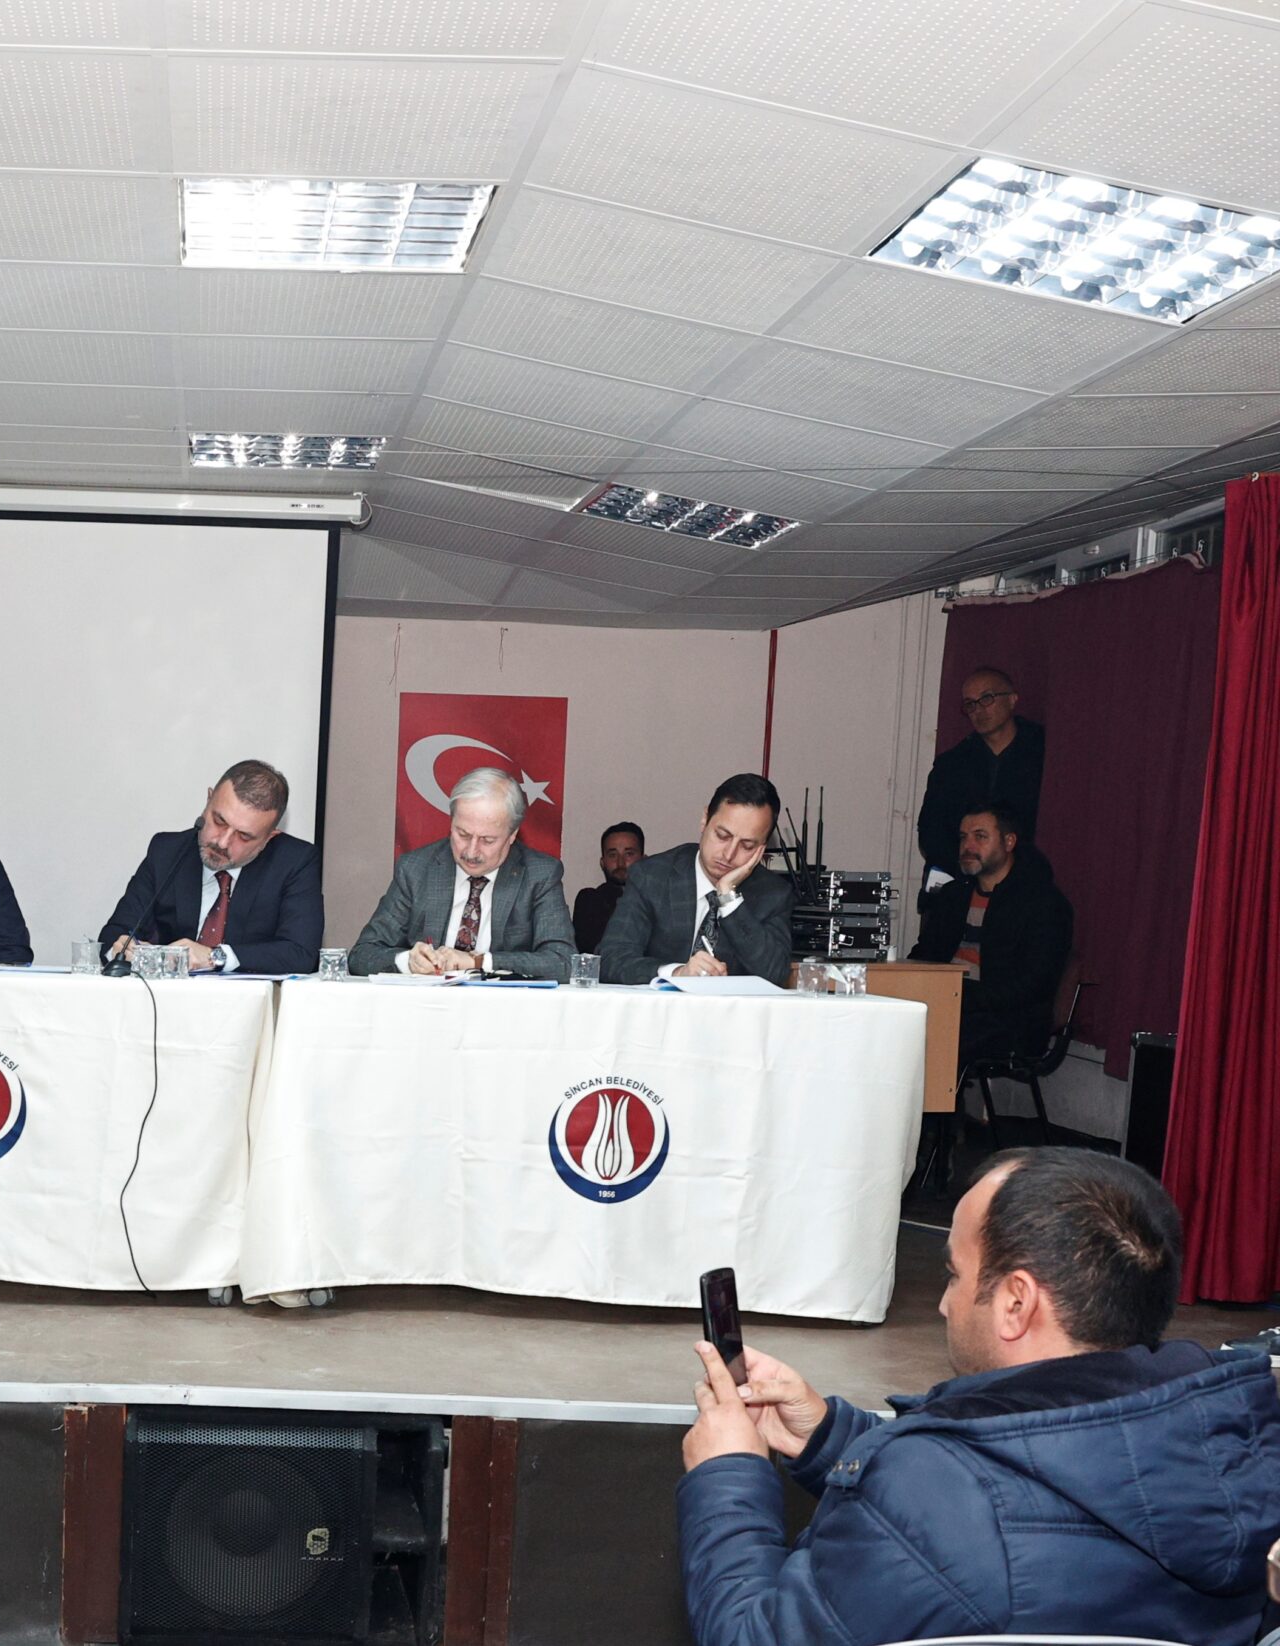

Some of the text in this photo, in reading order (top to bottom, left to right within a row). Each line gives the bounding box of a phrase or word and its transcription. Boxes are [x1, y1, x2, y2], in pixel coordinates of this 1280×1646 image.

[564, 1077, 665, 1106] SİNCAN BELEDİYESİ
[598, 1190, 616, 1198] 1956
